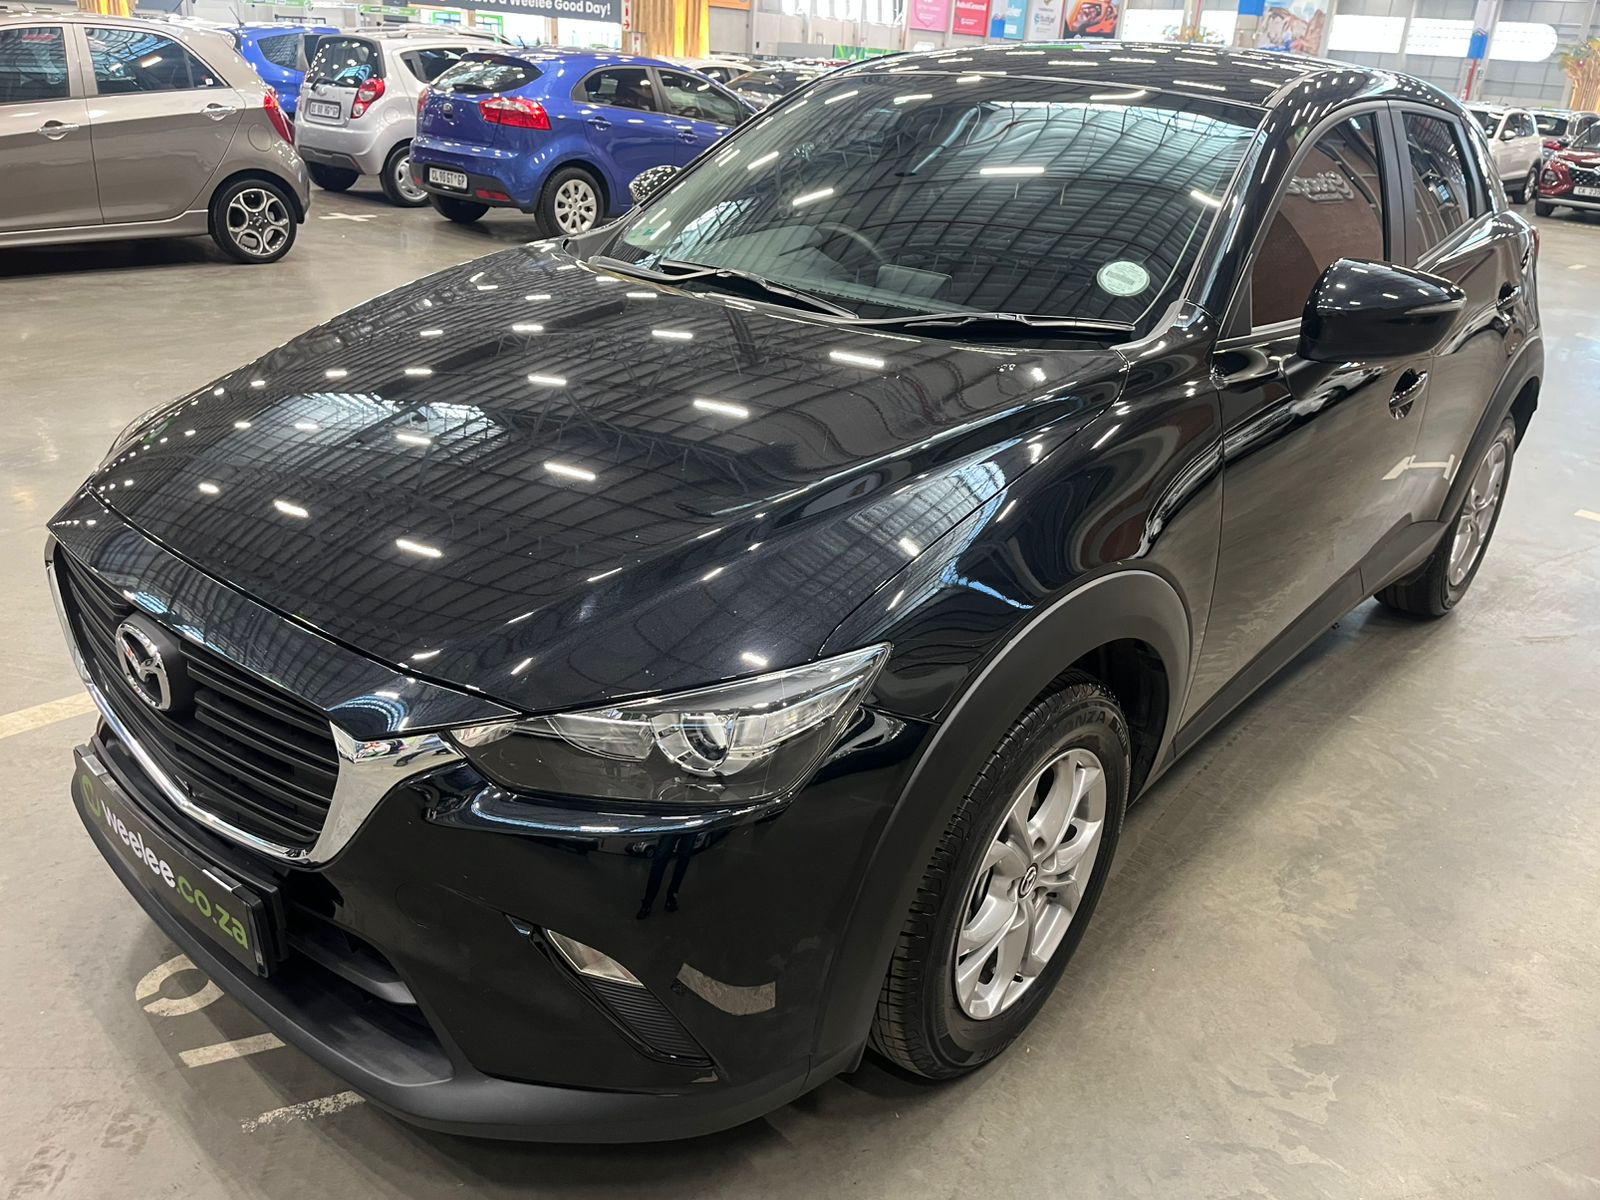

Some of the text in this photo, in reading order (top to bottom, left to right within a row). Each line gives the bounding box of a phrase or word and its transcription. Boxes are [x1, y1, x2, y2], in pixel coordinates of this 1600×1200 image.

[554, 0, 584, 12] Good
[585, 1, 611, 18] Day!
[101, 799, 249, 950] weelee.co.za
